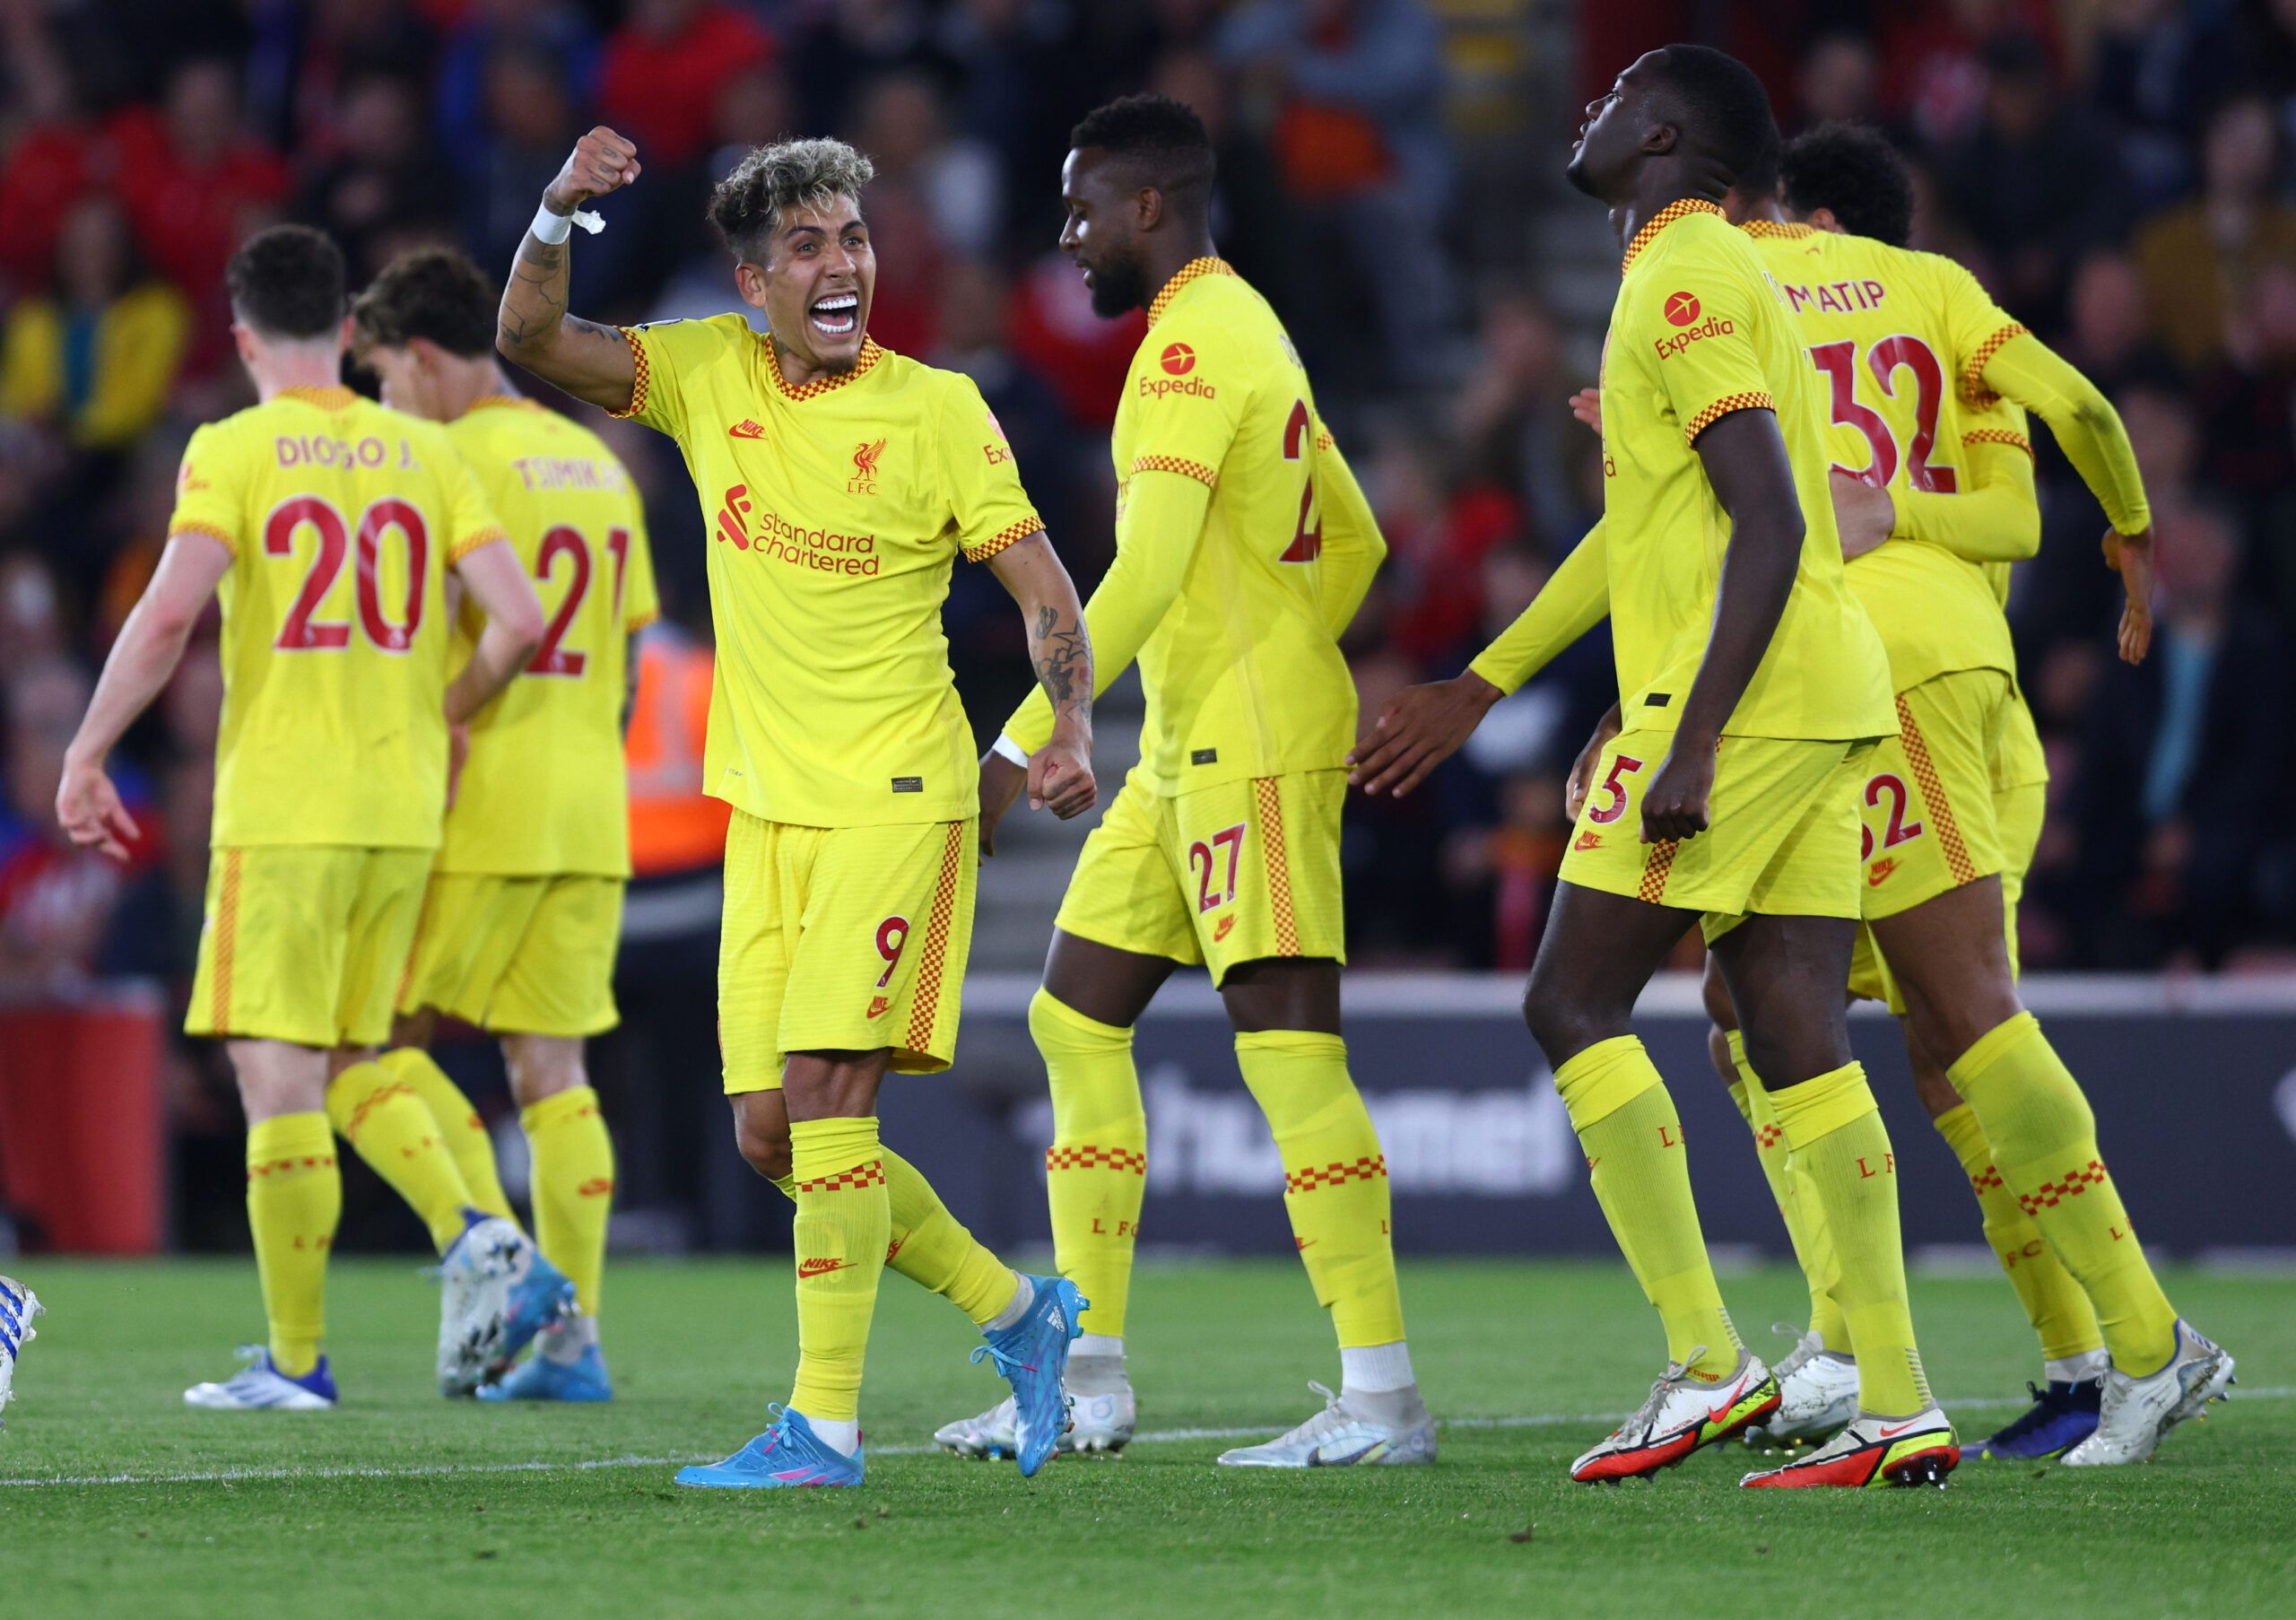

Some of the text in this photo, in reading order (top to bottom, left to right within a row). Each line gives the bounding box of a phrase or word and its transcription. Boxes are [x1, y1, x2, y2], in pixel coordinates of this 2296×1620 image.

[1782, 279, 1885, 313] MATIP
[1655, 317, 1734, 361] Expedia
[1140, 376, 1216, 400] Expedia
[737, 418, 765, 436] NIKE
[1810, 333, 1958, 495] 32
[274, 433, 386, 470] DIOGO
[760, 513, 874, 553] standard
[264, 494, 429, 655] 20
[753, 536, 880, 576] chartered
[525, 525, 631, 677] 21
[1587, 753, 1645, 825] 5
[1580, 830, 1603, 845] NIKE
[1188, 821, 1247, 915] 27
[874, 914, 910, 989] 9
[871, 995, 889, 1010] NIKE
[803, 1258, 842, 1268] NIKE
